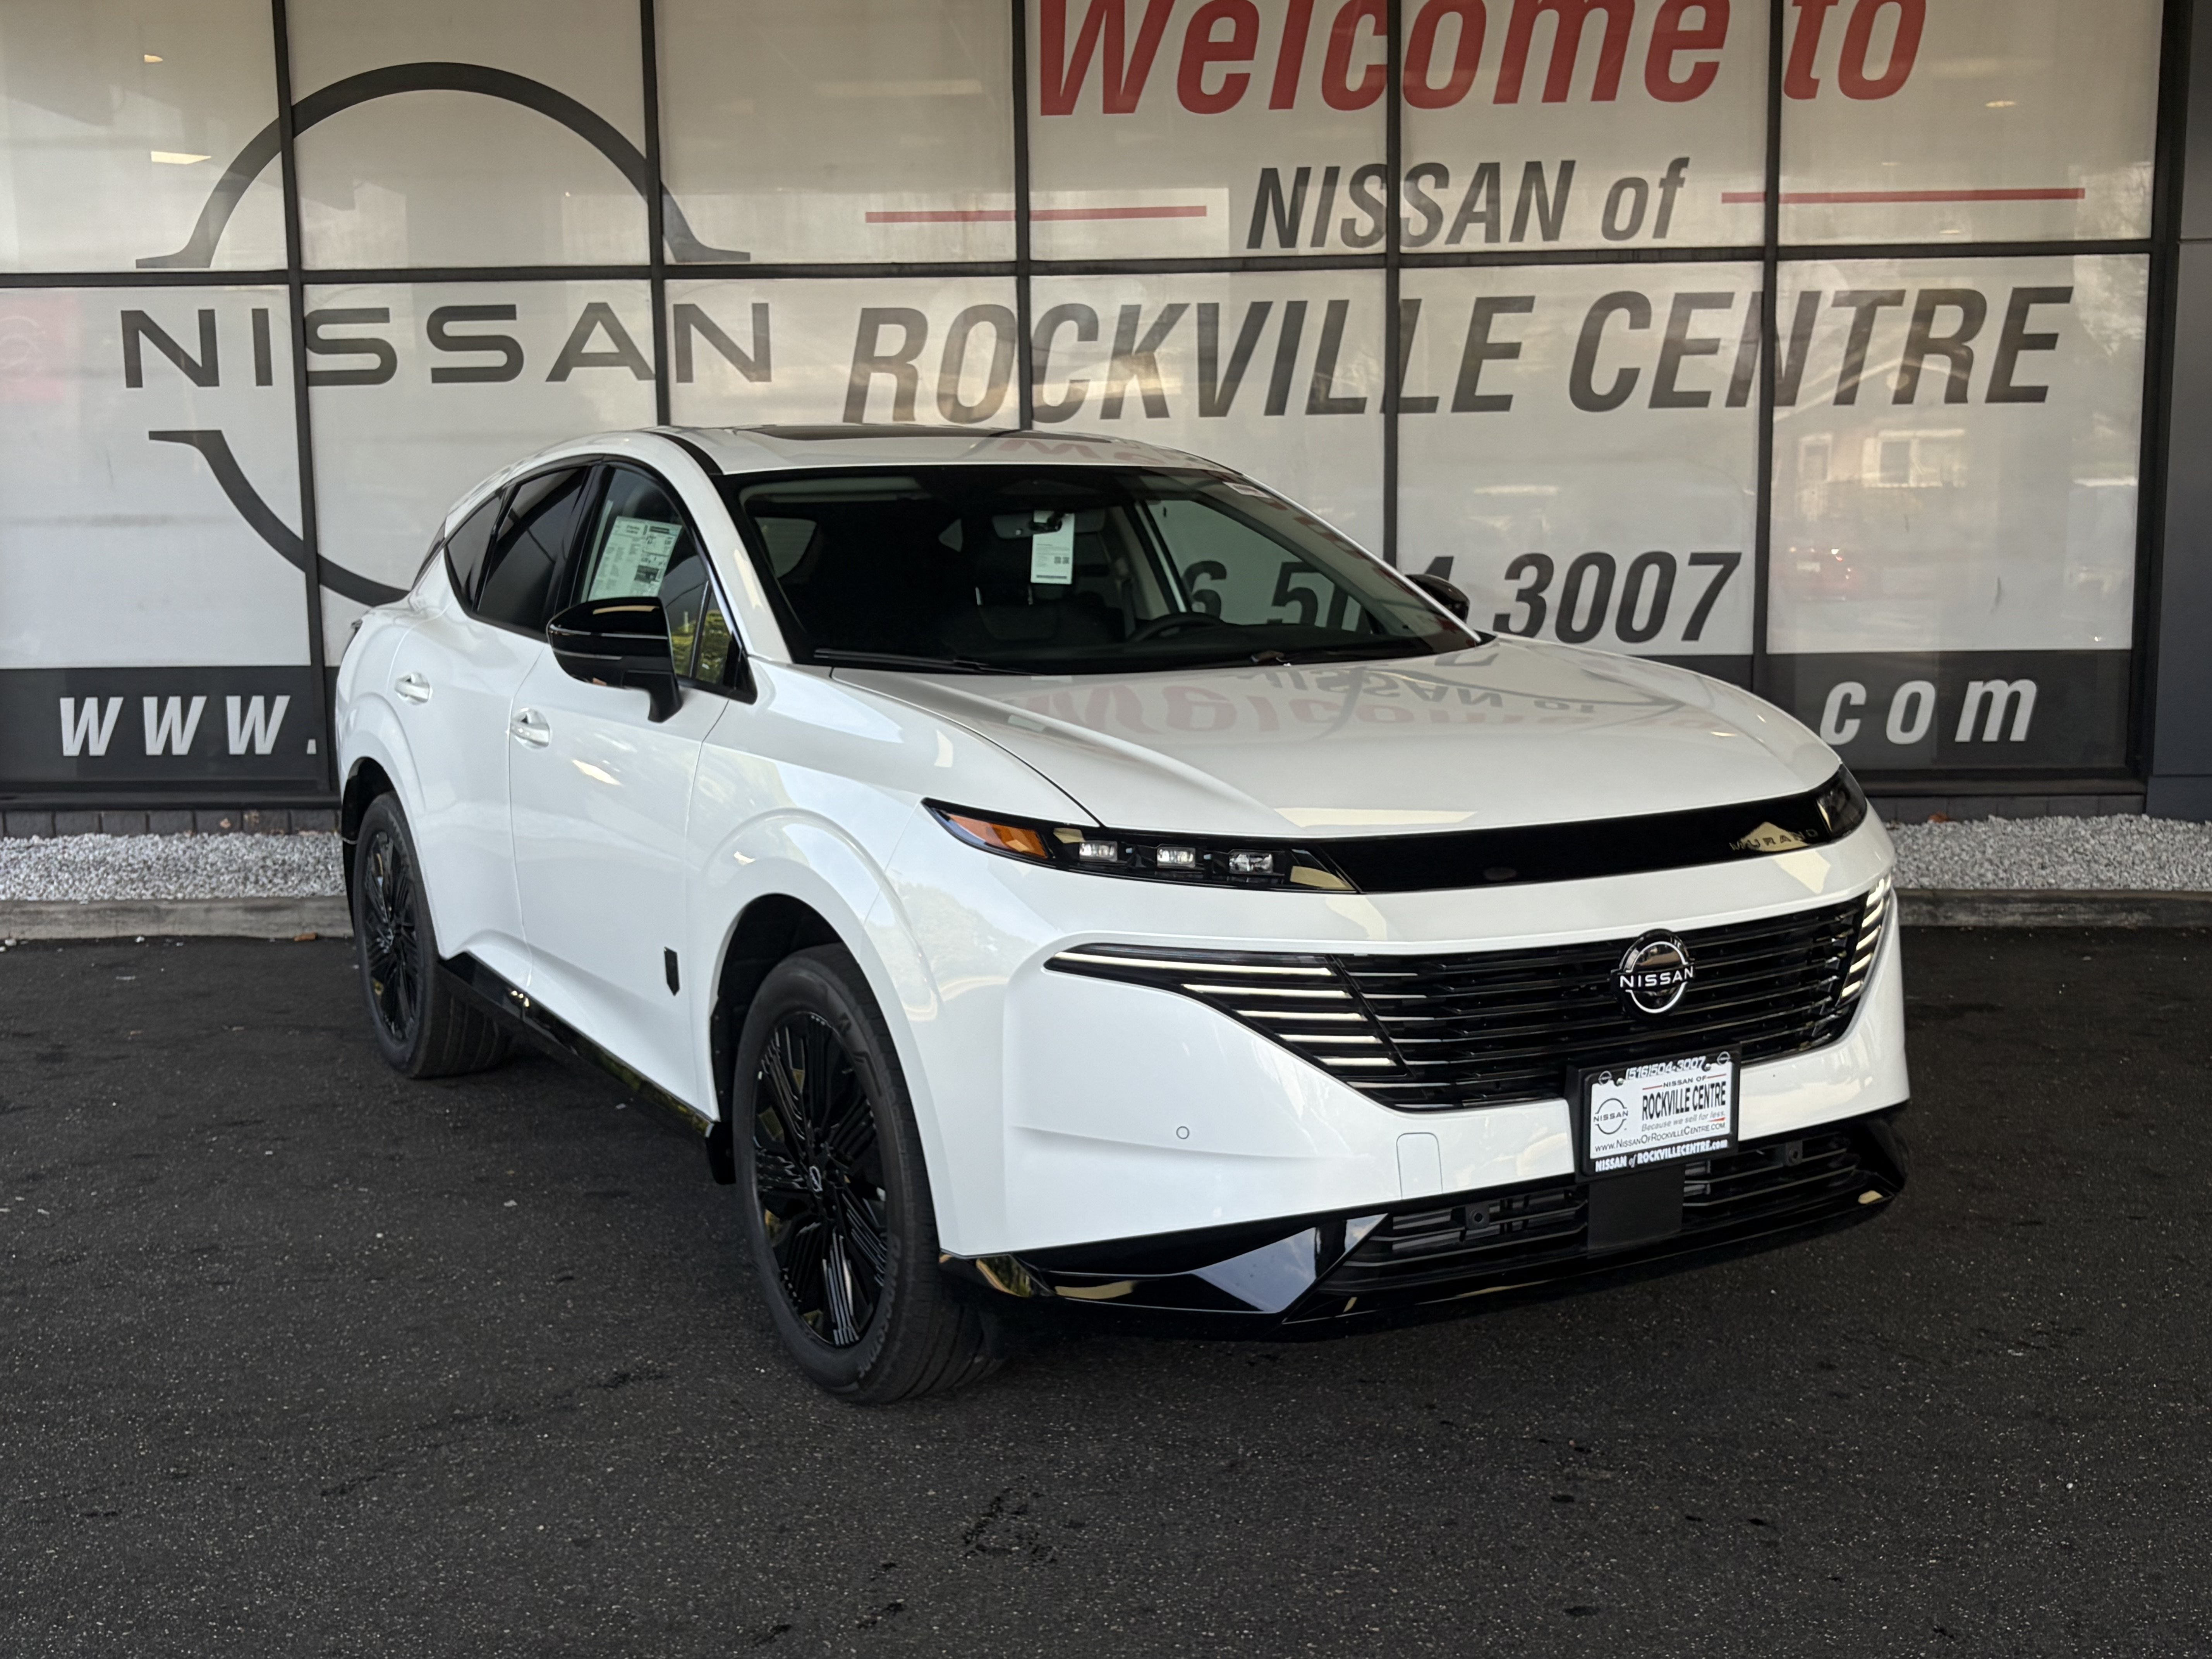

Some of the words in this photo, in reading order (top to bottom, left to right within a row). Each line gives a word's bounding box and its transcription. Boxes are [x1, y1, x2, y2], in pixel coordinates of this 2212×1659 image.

[1039, 0, 1730, 116] Welcome
[1783, 0, 1927, 101] to
[1247, 159, 1577, 249] NISSAN
[1600, 156, 1690, 242] of
[120, 302, 772, 388] NISSAN
[842, 294, 1536, 424] ROCKVILLE
[1568, 285, 2074, 413] CENTRE
[1492, 552, 1742, 644] 3007
[1819, 679, 2038, 745] com
[1729, 829, 1819, 851] MURANO
[1620, 966, 1693, 988] NISSAN
[1642, 1087, 1690, 1121] ROCKVILLE
[1692, 1081, 1726, 1111] CENTRE
[1663, 1077, 1693, 1088] NISSAN
[1594, 1110, 1628, 1122] NISSAN
[1642, 1120, 1671, 1132] Because
[1685, 1114, 1697, 1123] sell
[1595, 1155, 1627, 1173] NISSAN
[1628, 1154, 1637, 1168] of
[1637, 1139, 1728, 1164] ROCKVILLECENTRE.com
